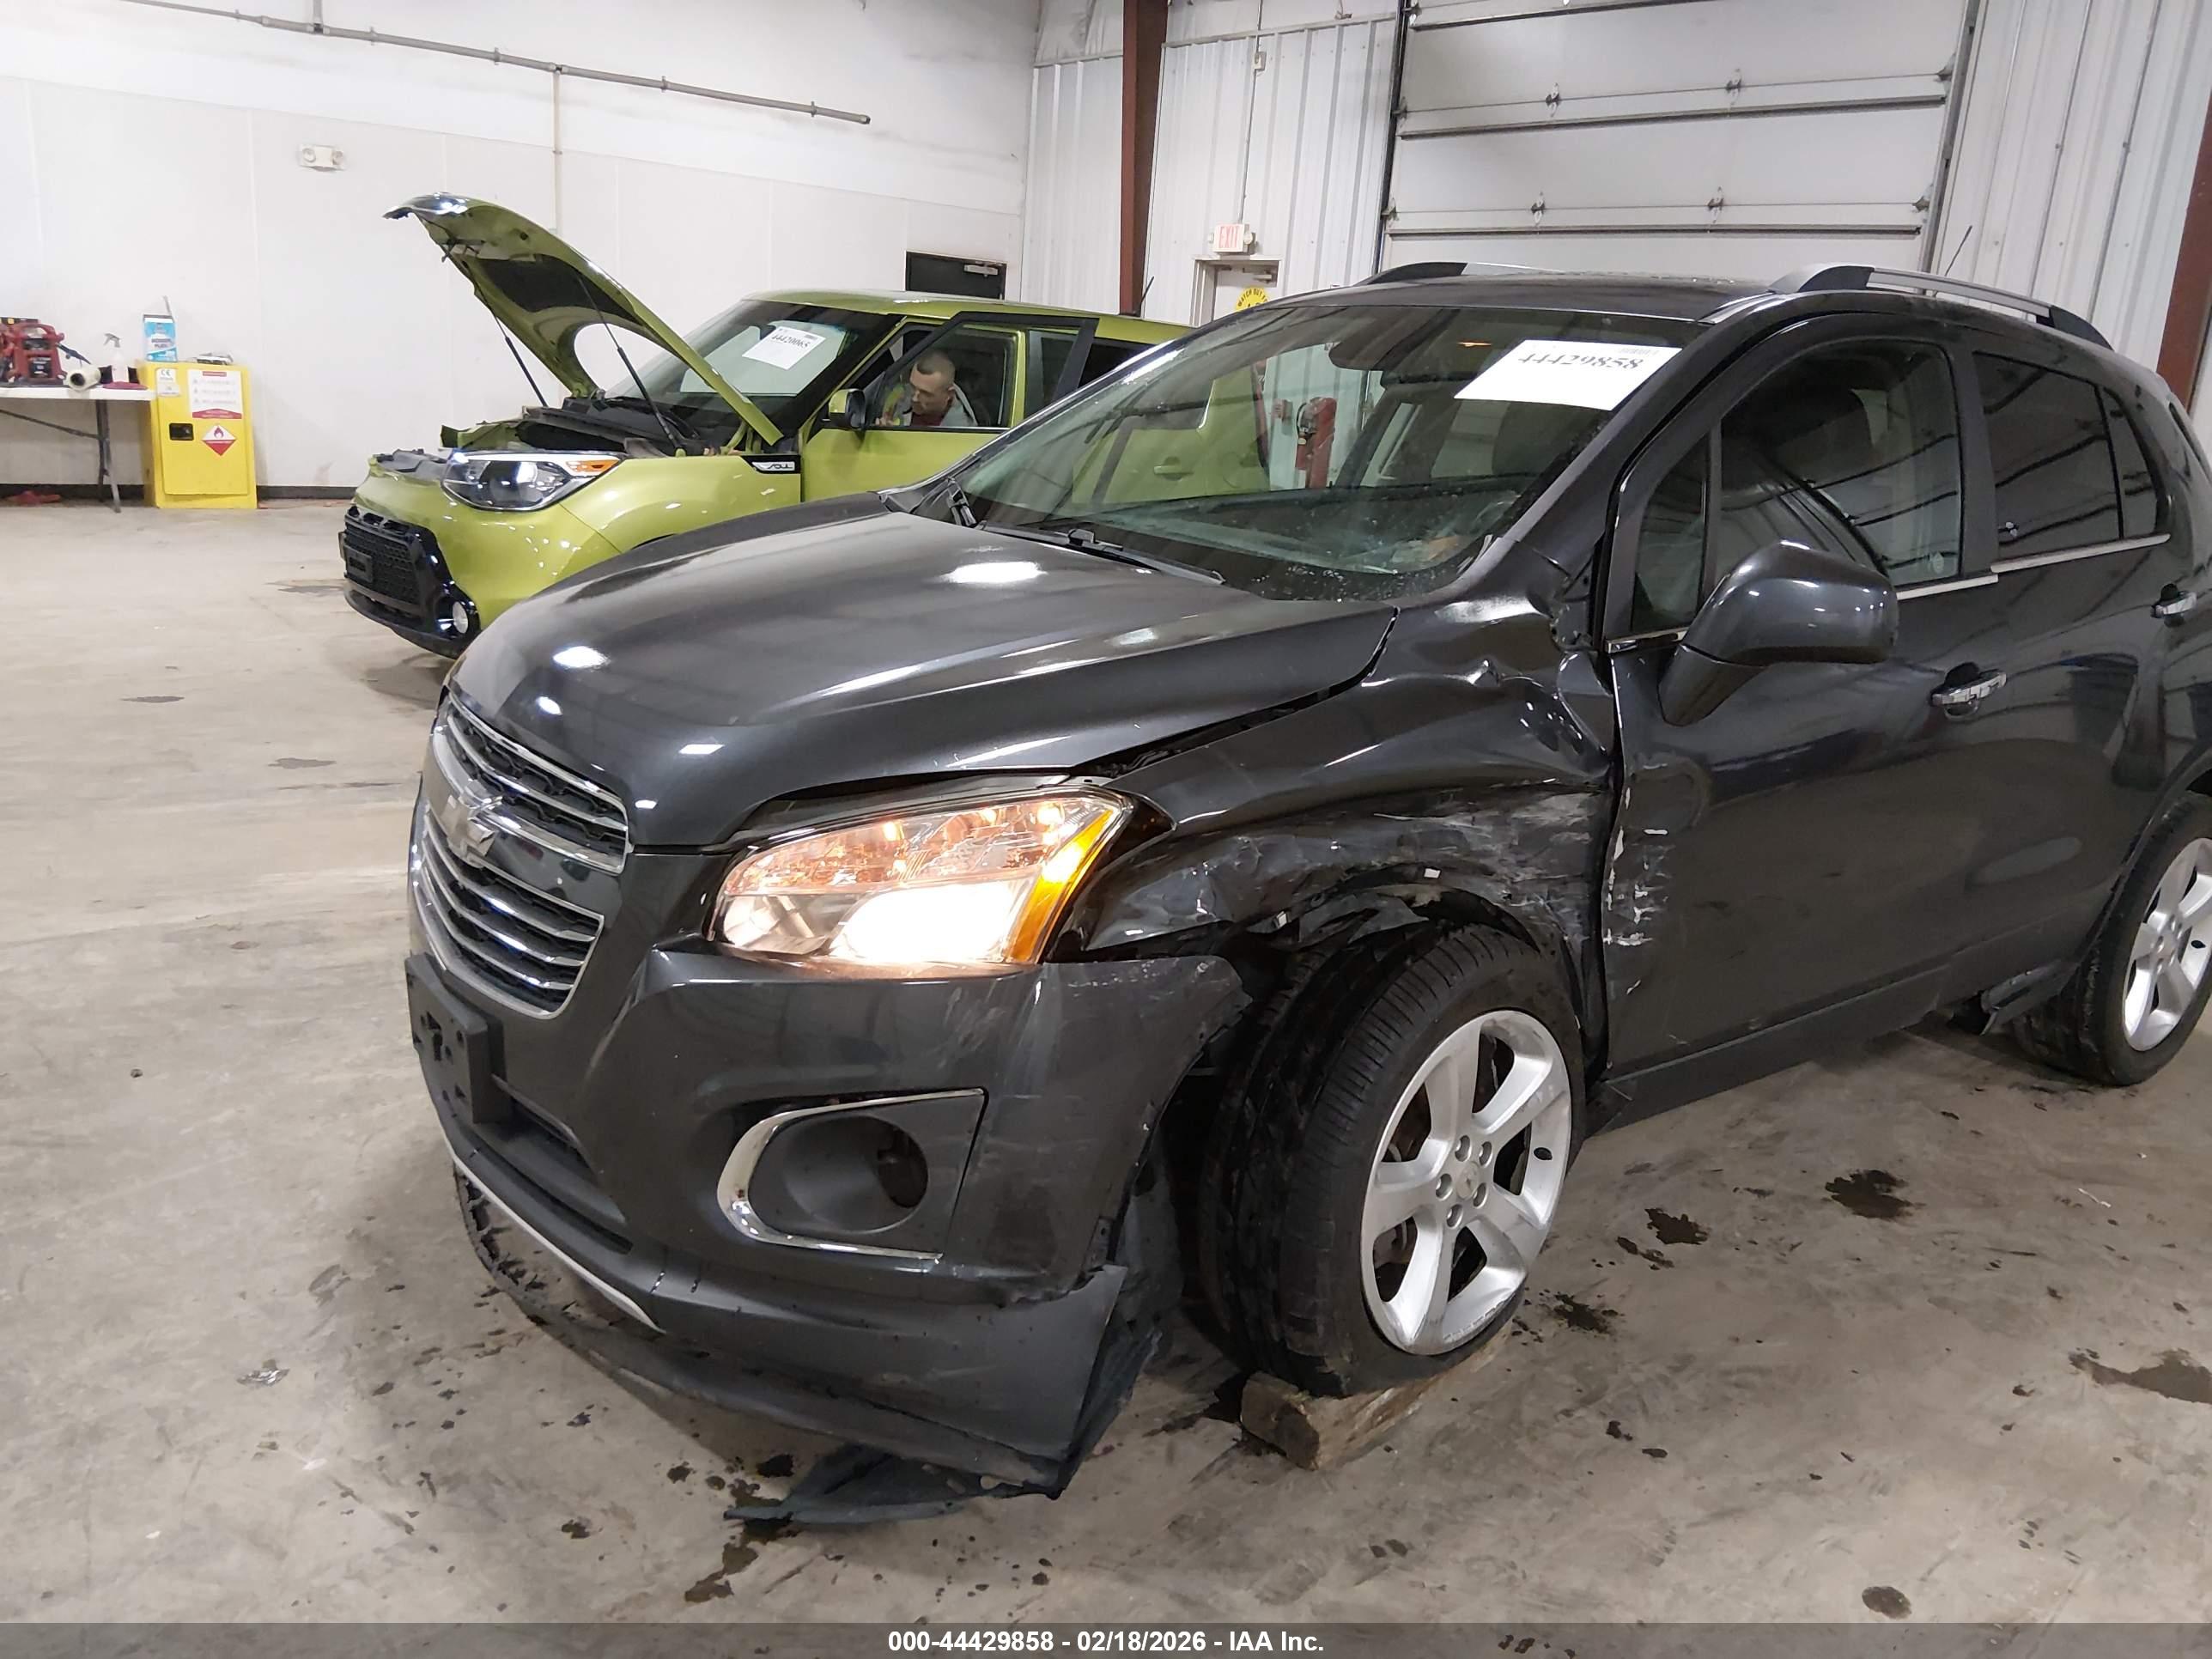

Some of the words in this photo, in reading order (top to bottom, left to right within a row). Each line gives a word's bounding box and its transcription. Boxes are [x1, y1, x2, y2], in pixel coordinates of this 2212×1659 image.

[1218, 226, 1239, 248] EXIT
[1237, 289, 1252, 307] WATCH
[1518, 353, 1644, 369] 44429858
